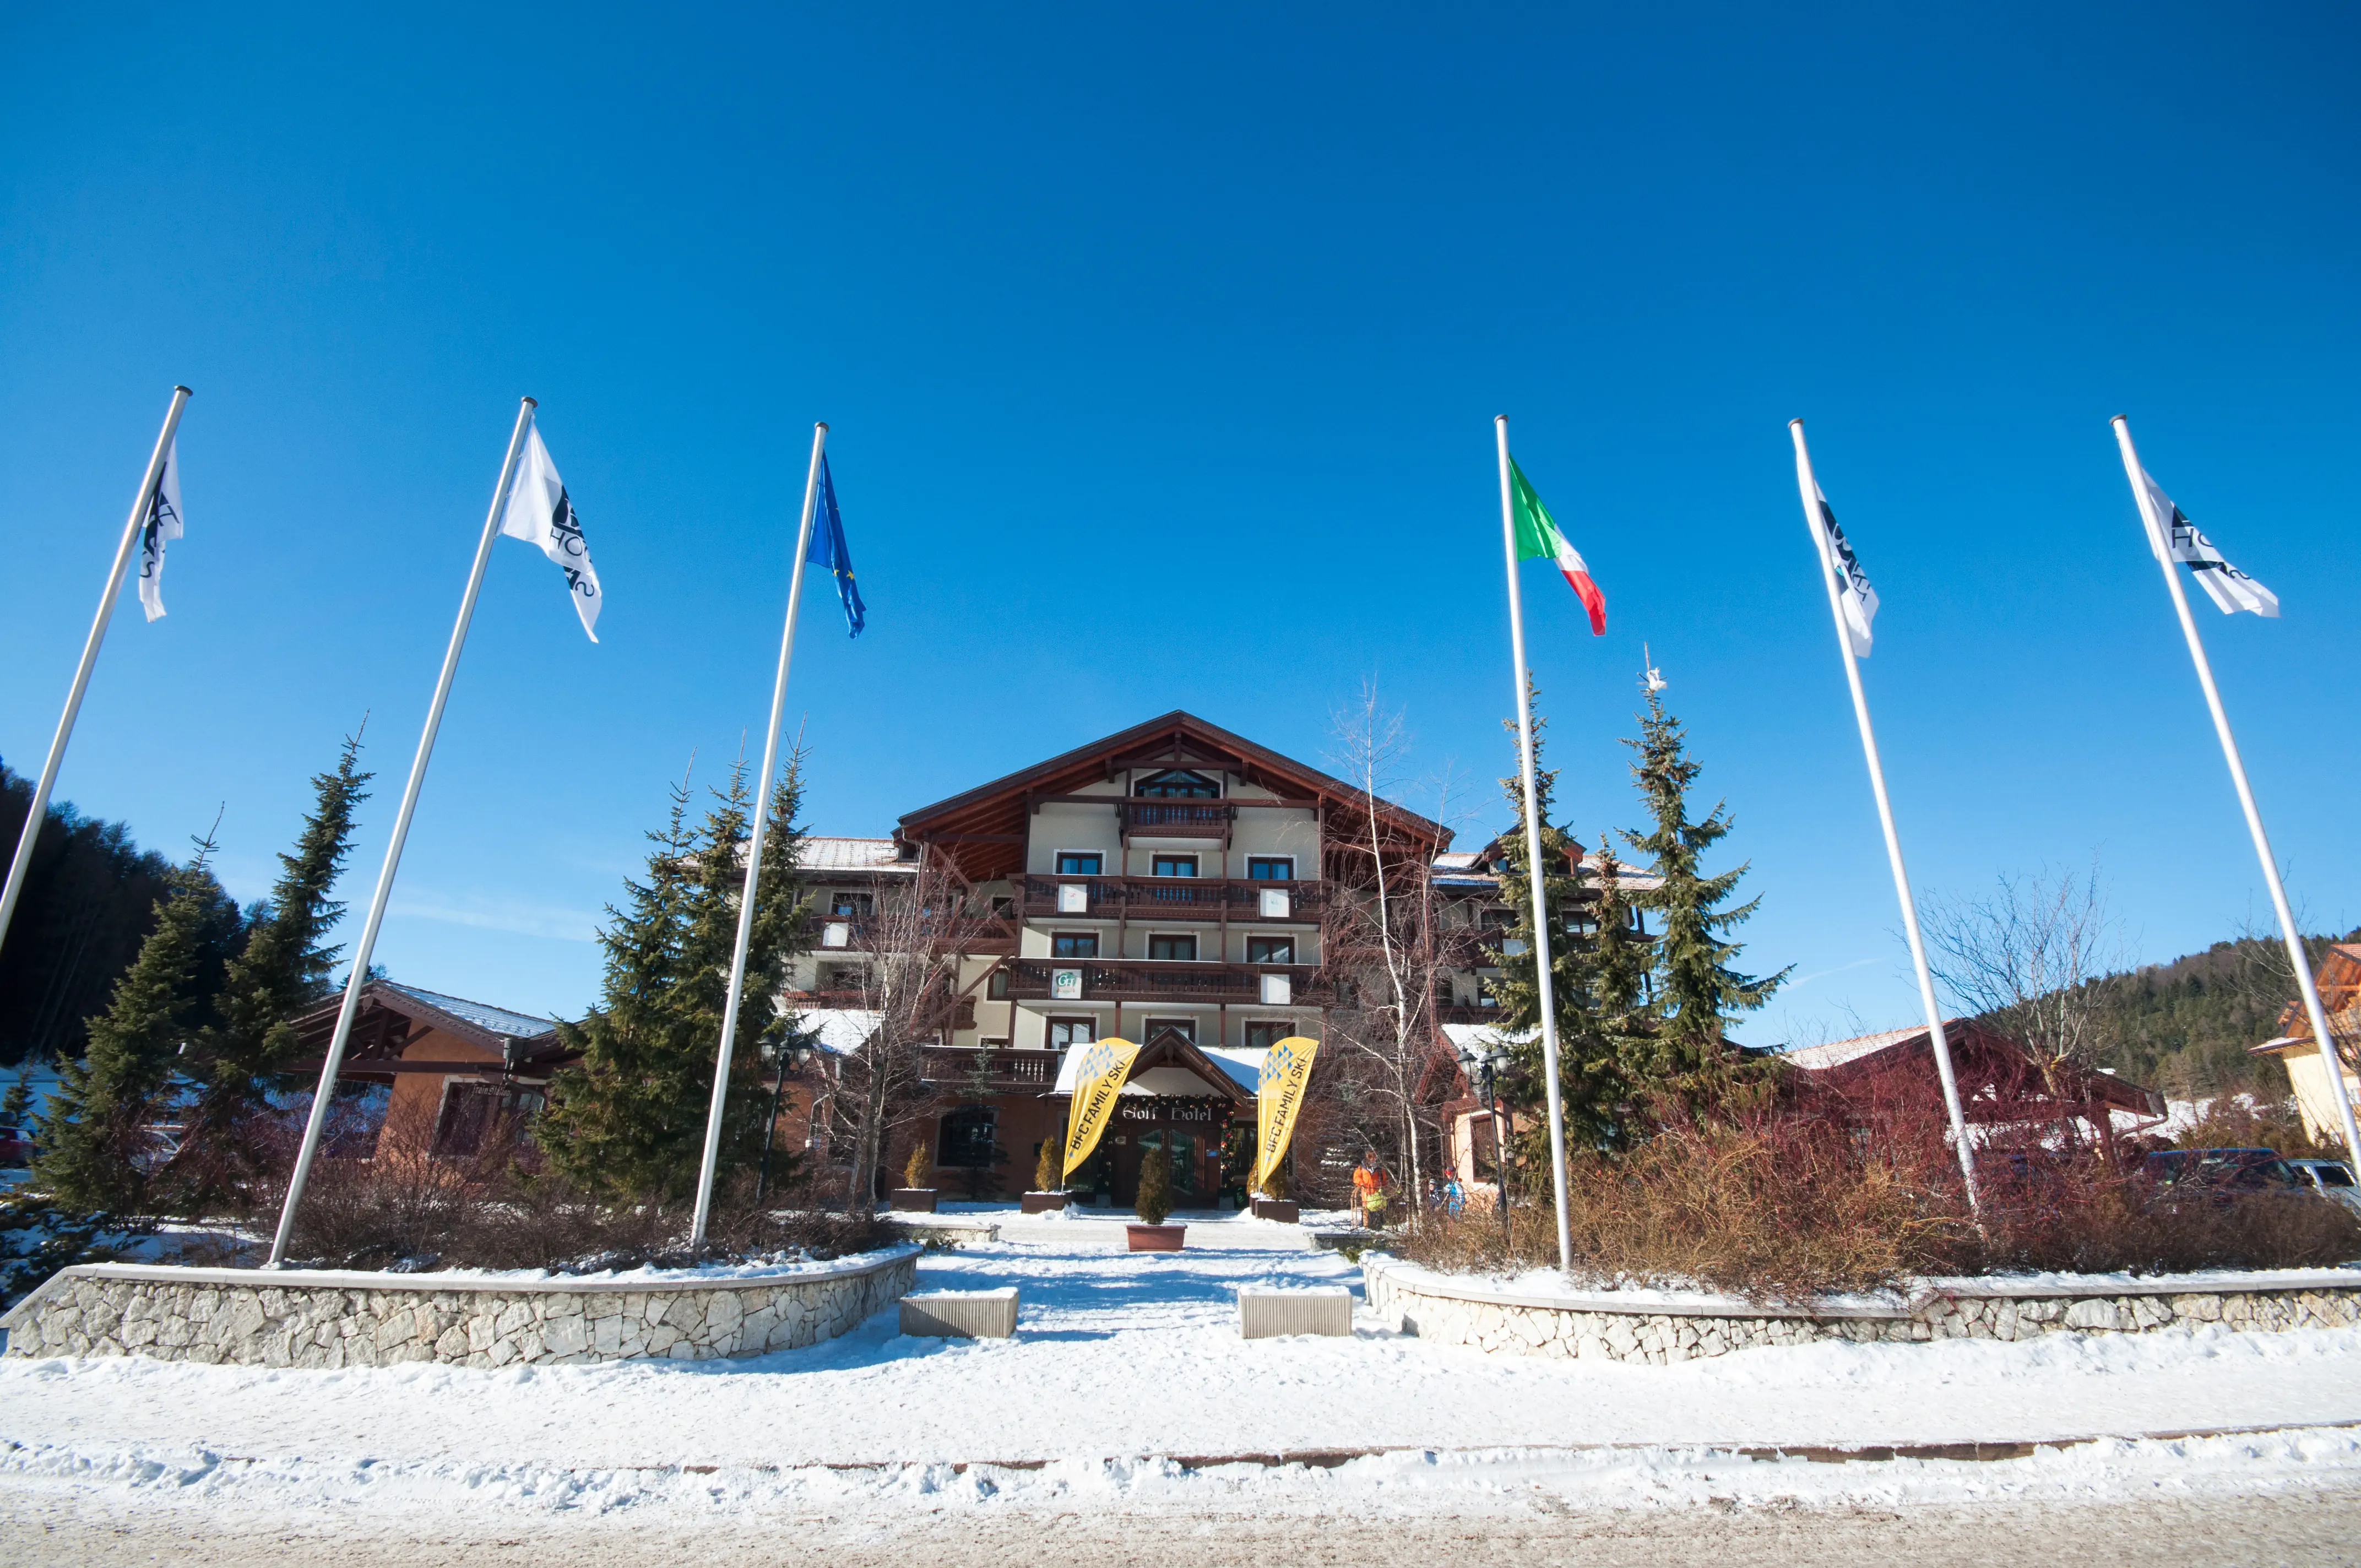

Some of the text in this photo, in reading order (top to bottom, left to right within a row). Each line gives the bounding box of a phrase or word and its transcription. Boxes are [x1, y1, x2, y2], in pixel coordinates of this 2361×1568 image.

[1070, 1059, 1126, 1150] BFC FAMILY SKI
[1122, 1103, 1212, 1121] Golf Hotel
[1266, 1057, 1307, 1153] BFC FAMILY SKI
